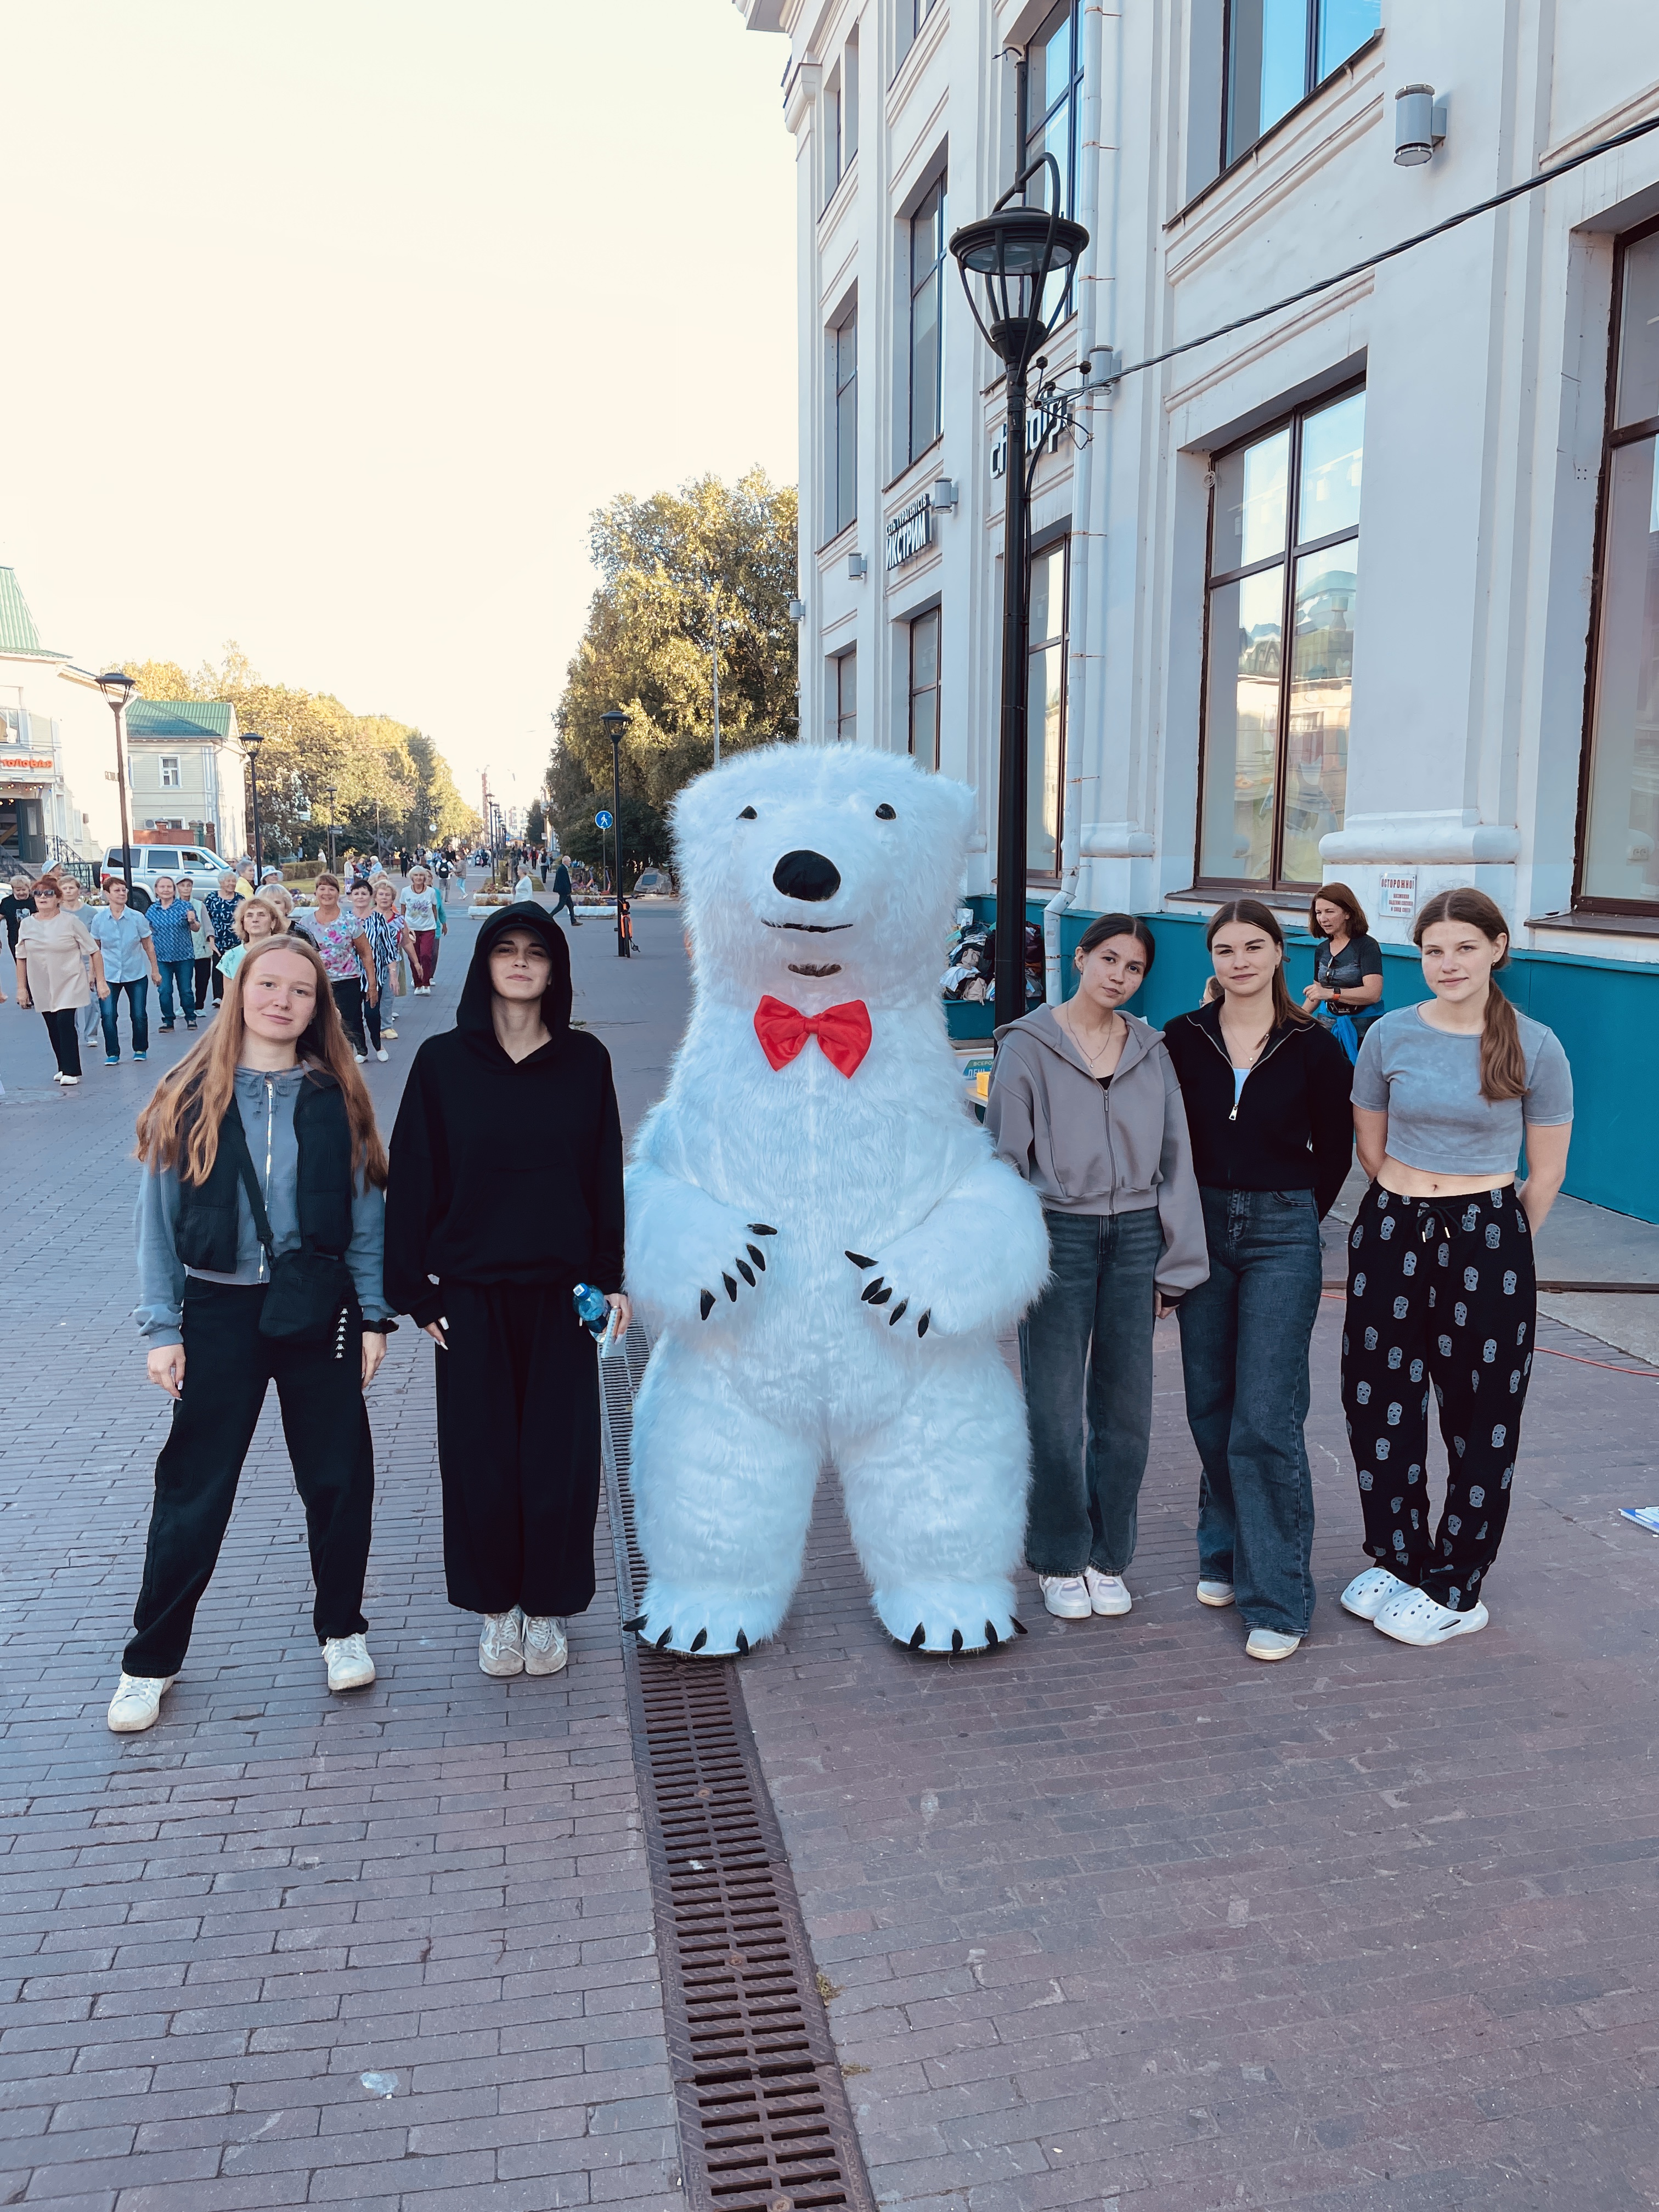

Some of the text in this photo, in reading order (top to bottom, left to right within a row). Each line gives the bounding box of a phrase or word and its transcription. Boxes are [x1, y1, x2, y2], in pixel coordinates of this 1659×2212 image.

[885, 493, 927, 537] СЕТЬ ТУРАГЕНТСТВ
[885, 510, 926, 571] ИКСТРИМ
[0, 759, 53, 768] ТОЛОВАЯ
[1381, 879, 1414, 889] ОСТОРОЖНО!
[968, 1069, 985, 1079] ДЕ
